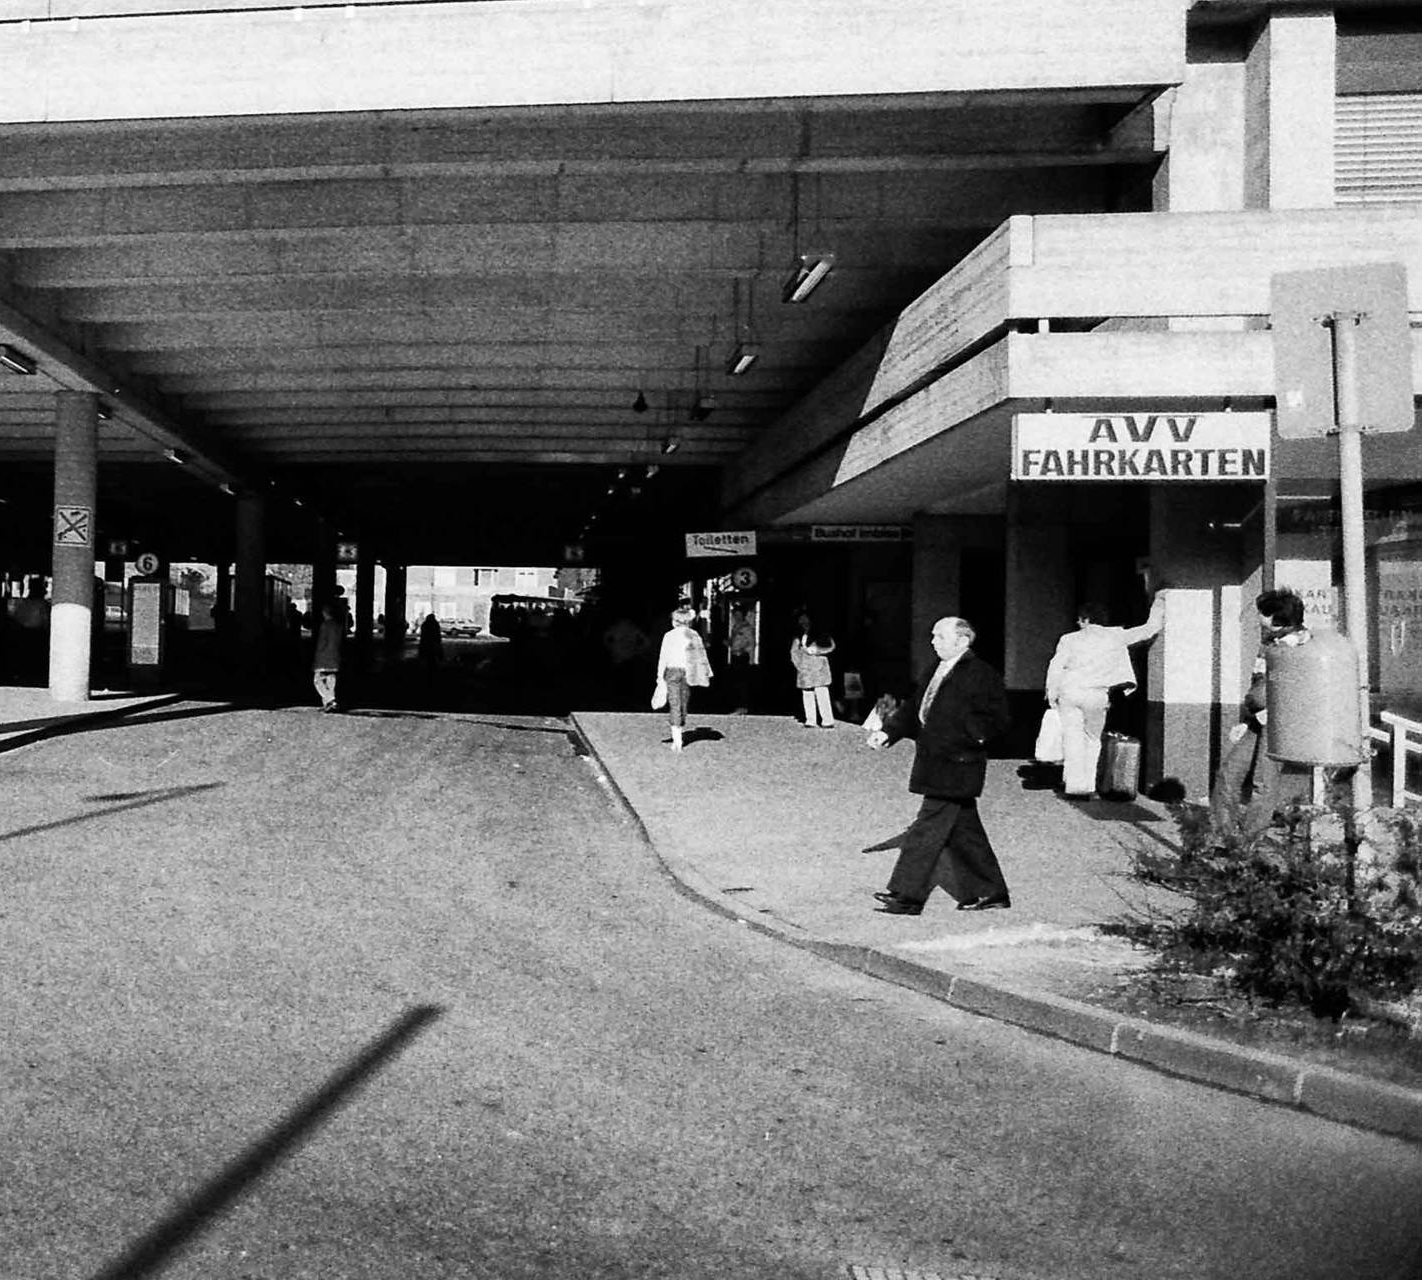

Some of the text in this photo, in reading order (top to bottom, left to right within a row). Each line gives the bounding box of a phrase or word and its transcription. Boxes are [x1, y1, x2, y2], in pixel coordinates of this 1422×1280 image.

[1088, 415, 1198, 444] AVV
[1021, 448, 1266, 477] FAHRKARTEN
[692, 534, 749, 546] Toiletten
[143, 556, 153, 572] 6
[740, 571, 751, 586] 3
